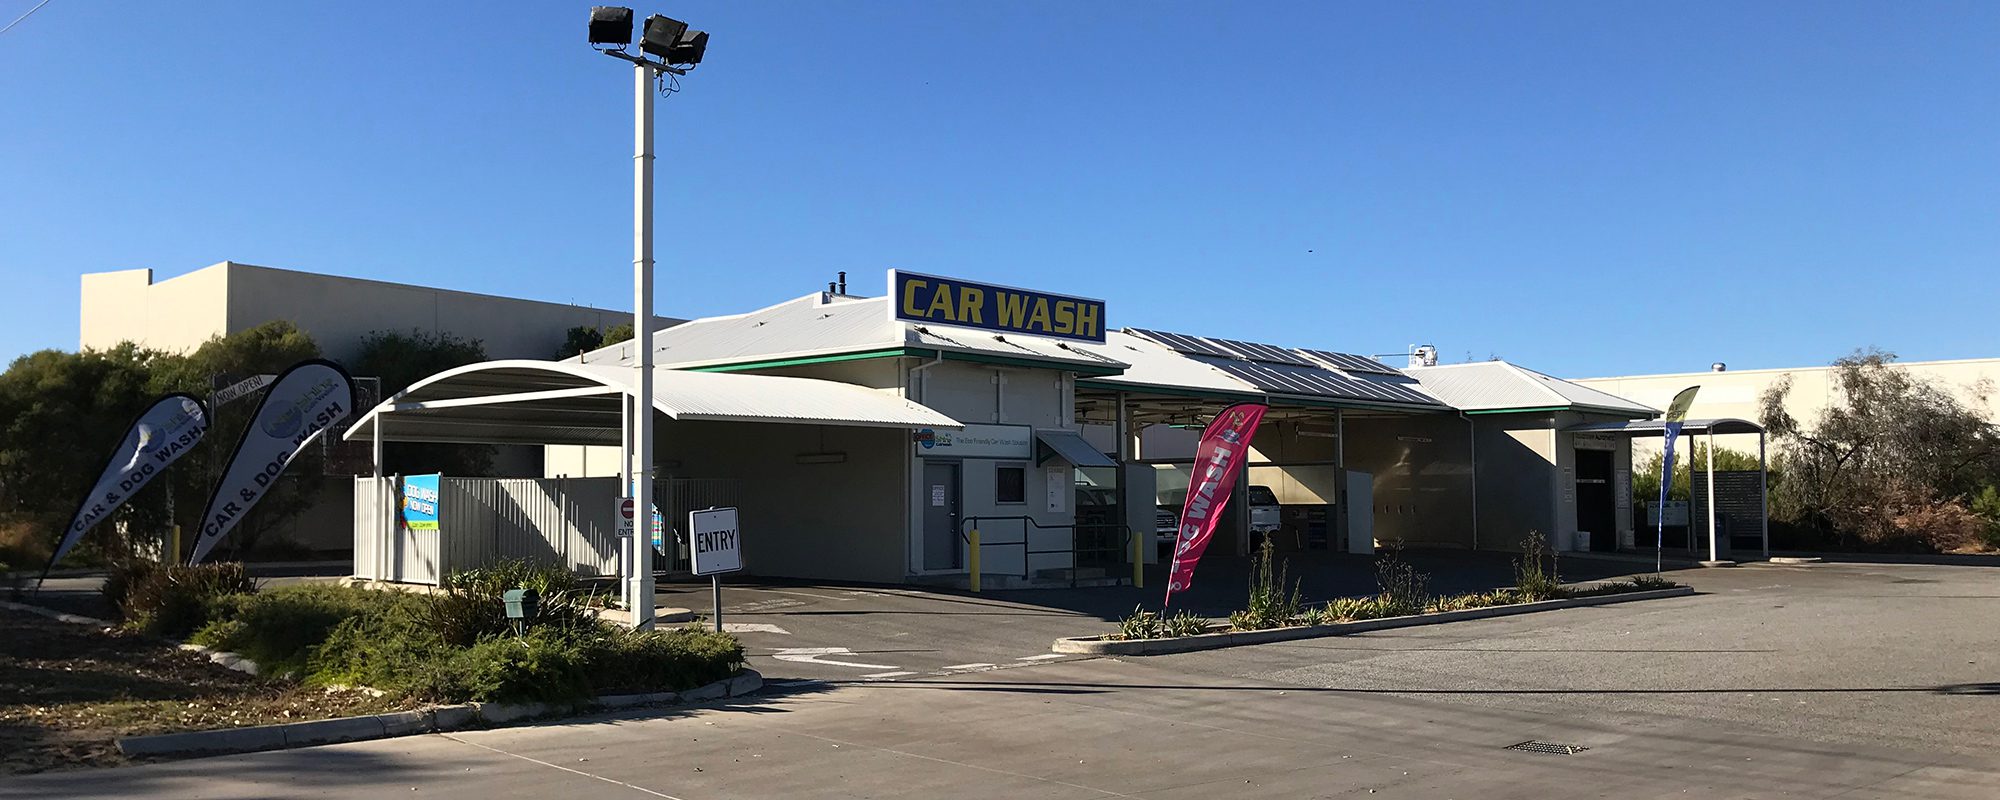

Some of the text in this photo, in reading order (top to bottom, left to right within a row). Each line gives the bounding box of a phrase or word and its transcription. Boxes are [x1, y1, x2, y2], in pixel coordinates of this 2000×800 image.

[903, 279, 1099, 338] CAR WASH
[216, 376, 263, 402] NOW OPEN!
[74, 425, 202, 532] CAR & DOG WASH
[205, 501, 242, 537] CAR
[240, 488, 257, 502] &
[254, 451, 291, 488] DOG
[292, 401, 343, 448] WASH
[1188, 447, 1232, 520] WASH
[407, 484, 438, 504] DOG WASH
[409, 500, 434, 516] NOW OPEN
[697, 529, 736, 554] ENTRY
